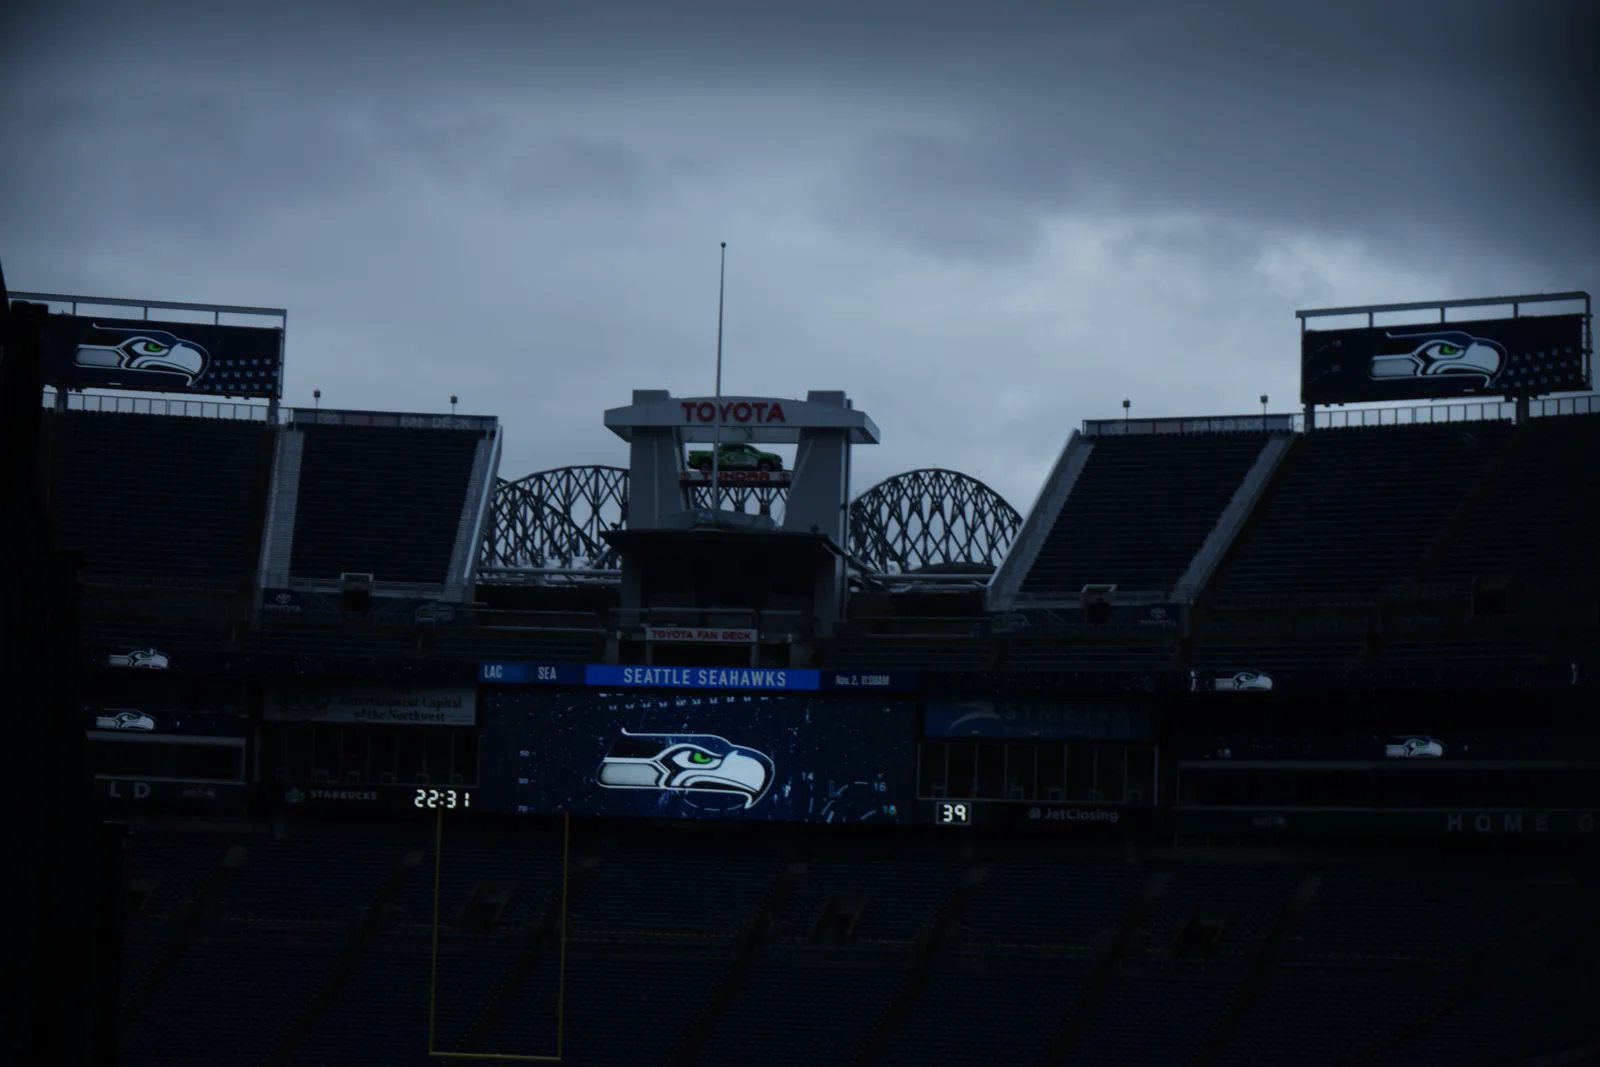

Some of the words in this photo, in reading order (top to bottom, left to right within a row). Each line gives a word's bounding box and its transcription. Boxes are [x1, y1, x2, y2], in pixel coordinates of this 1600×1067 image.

[681, 402, 785, 422] TOYOTA
[701, 472, 770, 481] TUNDRA
[651, 630, 693, 639] TOYOTA
[697, 631, 718, 639] FAN
[722, 632, 751, 640] DECK
[484, 665, 503, 678] LAC
[538, 667, 557, 680] SEA
[624, 668, 690, 684] SEATTLE
[698, 669, 787, 687] SEAHAWKS
[422, 697, 463, 711] Capital
[354, 709, 365, 718] of
[368, 709, 385, 719] the
[388, 709, 445, 722] Northwest
[309, 789, 378, 801] STARBUCKS
[414, 788, 470, 809] 22:31
[942, 804, 967, 823] 39
[1044, 808, 1119, 822] JetClosing
[1448, 814, 1549, 832] HOME
